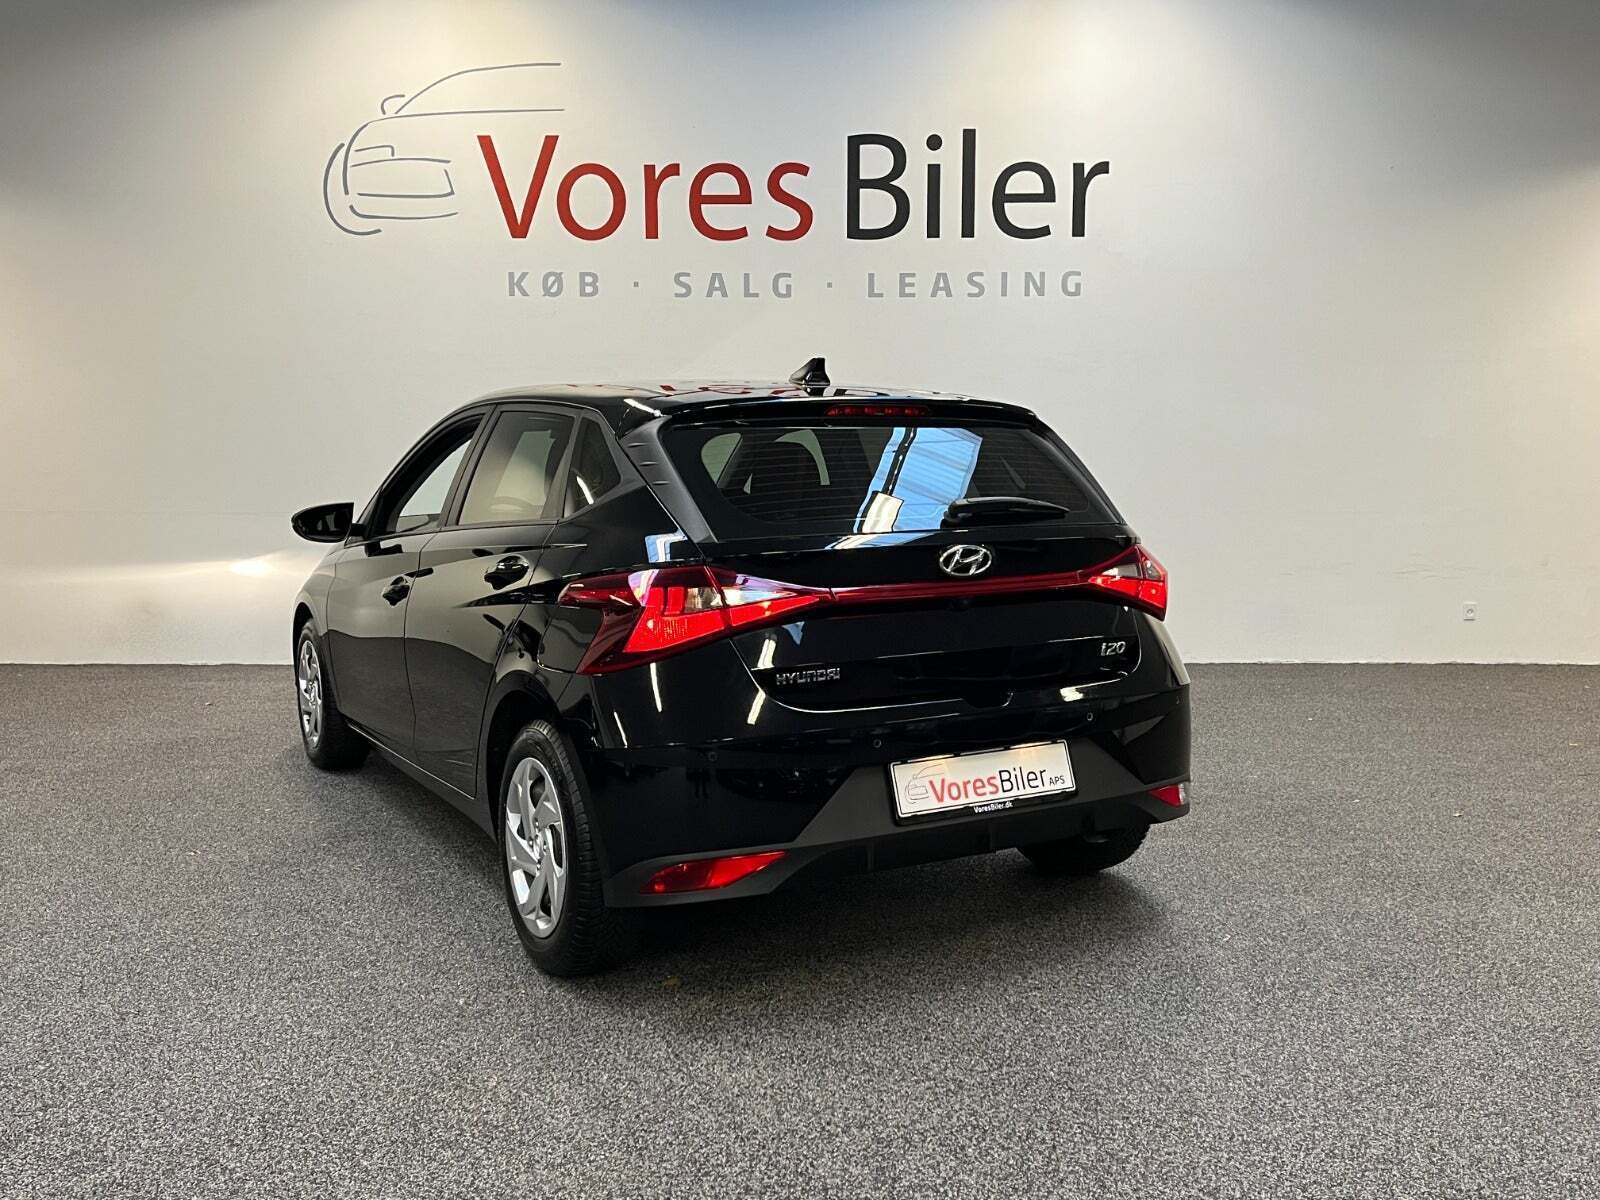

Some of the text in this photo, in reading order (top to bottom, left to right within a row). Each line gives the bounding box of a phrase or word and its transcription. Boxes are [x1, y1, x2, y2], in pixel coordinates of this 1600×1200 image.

[477, 129, 1110, 241] Vores Biler
[507, 271, 1082, 299] KØB SALG LEASING
[1100, 641, 1126, 657] i20
[776, 668, 841, 686] HYUNDAI
[1049, 775, 1065, 786] APS
[973, 801, 1013, 814] VoresBiler.dk
